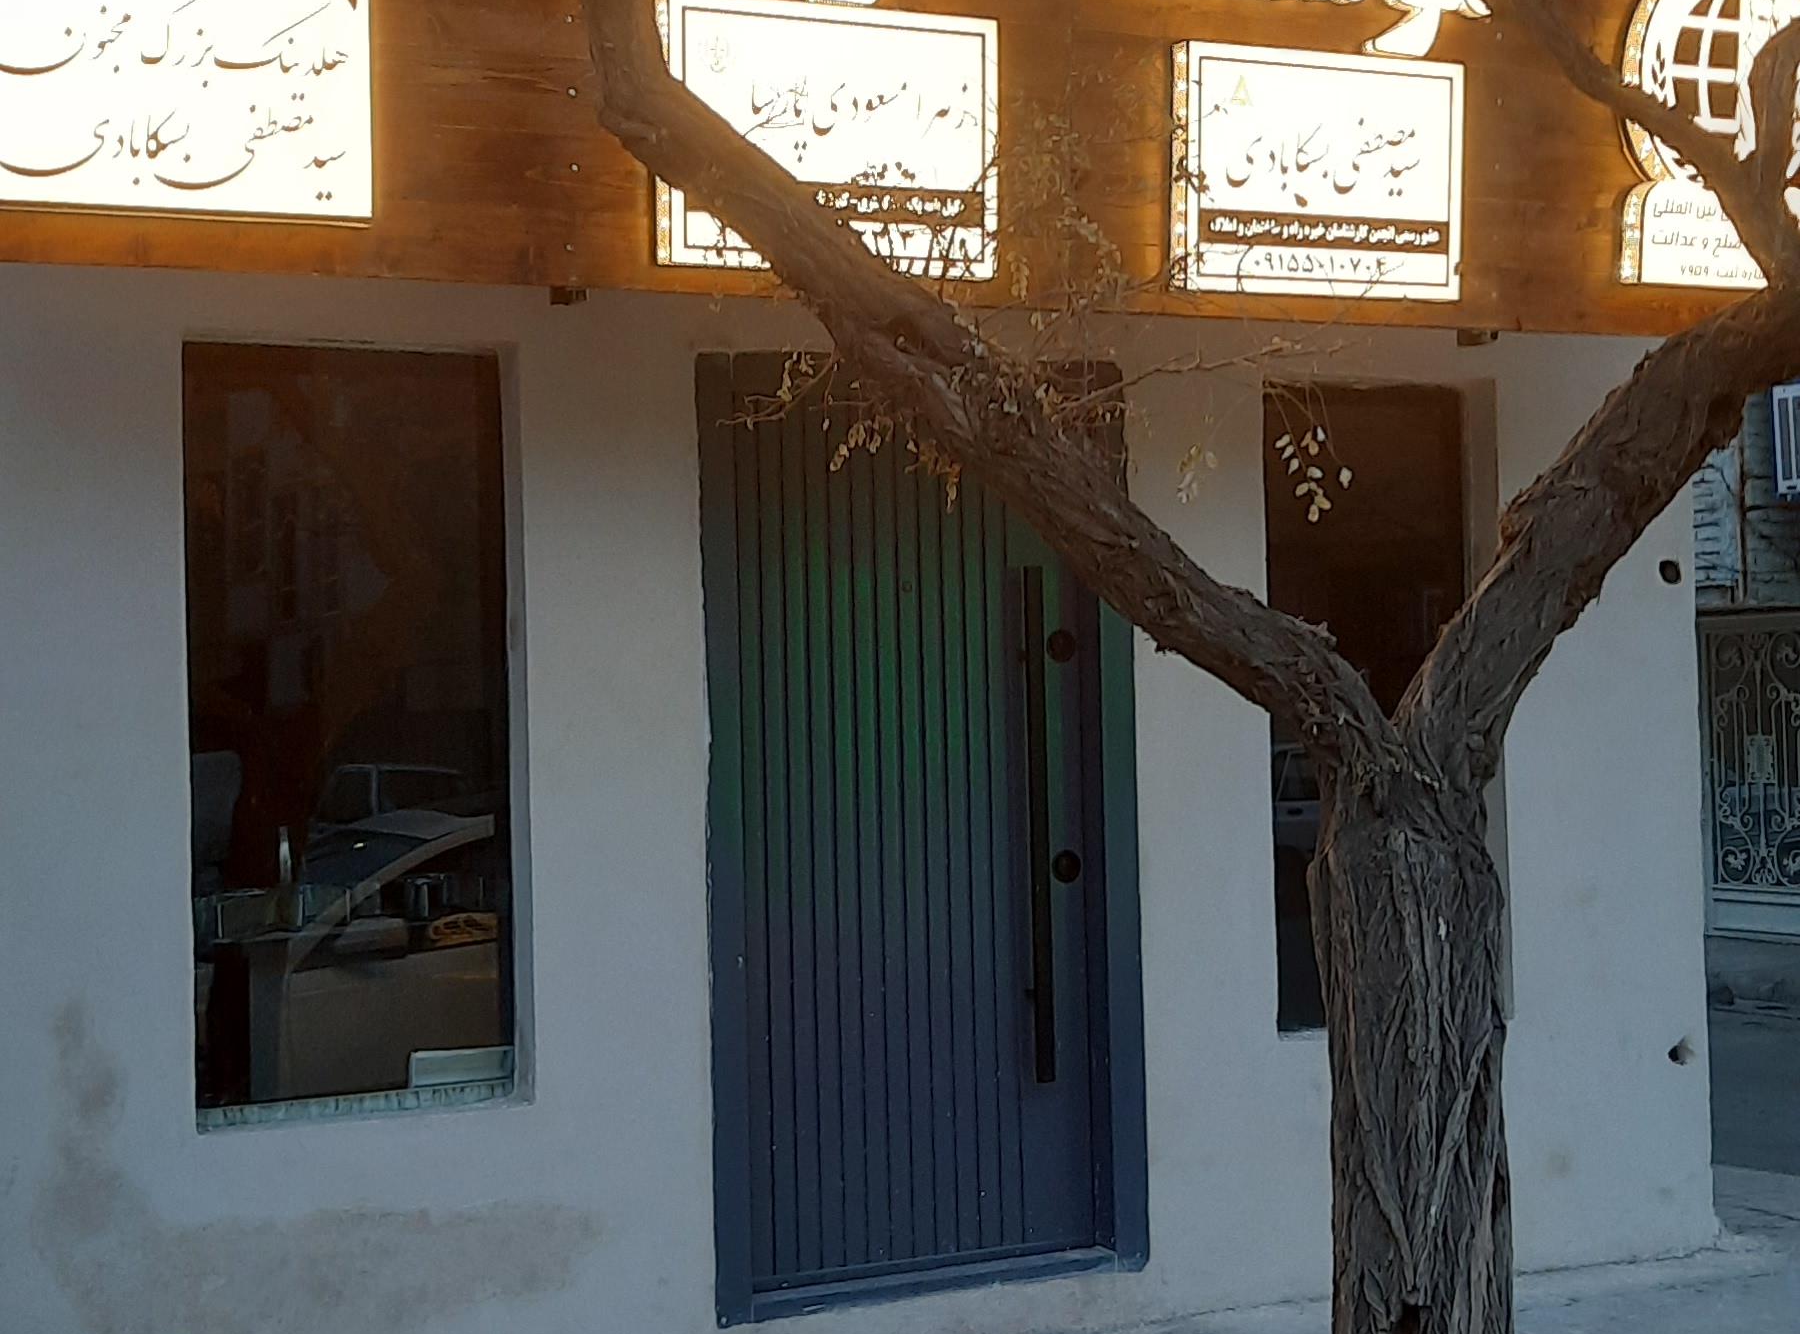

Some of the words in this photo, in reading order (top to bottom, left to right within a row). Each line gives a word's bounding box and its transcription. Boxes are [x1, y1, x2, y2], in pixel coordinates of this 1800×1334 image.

[153, 104, 315, 191] مصطفی
[303, 150, 347, 201] سید
[1651, 229, 1698, 247] عدالت
